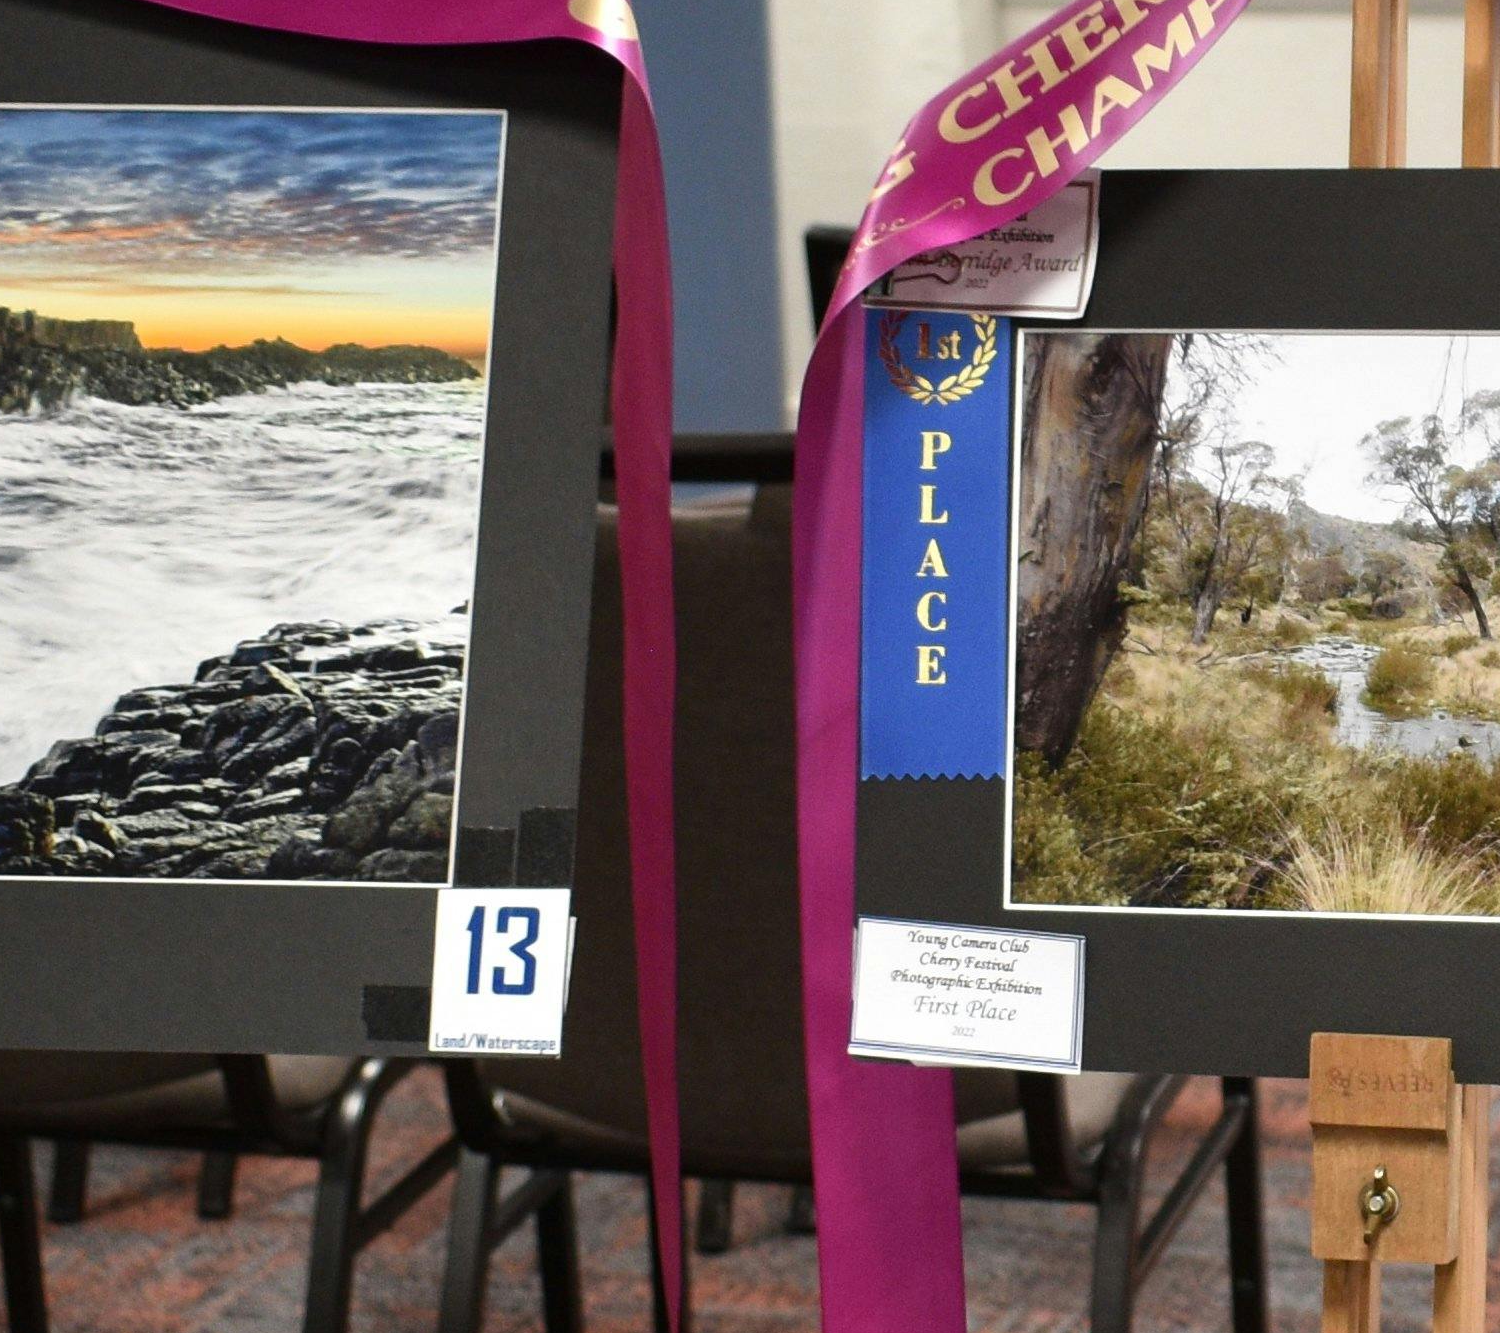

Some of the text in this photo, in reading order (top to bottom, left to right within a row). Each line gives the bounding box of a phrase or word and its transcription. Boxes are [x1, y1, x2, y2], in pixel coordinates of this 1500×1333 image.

[1013, 251, 1086, 274] Award
[964, 277, 989, 290] 2022
[915, 322, 962, 361] 1st
[914, 430, 953, 686] PLACE
[466, 905, 541, 996] 13
[907, 930, 1031, 953] Young Camera Club
[919, 951, 1018, 973] Cherry Festival
[890, 969, 1044, 996] Photographic Exhibition
[913, 994, 1018, 1022] First Place
[435, 1033, 557, 1053] Land/Waterscape
[951, 1025, 977, 1038] 2022
[1357, 1072, 1435, 1094] REEVES
